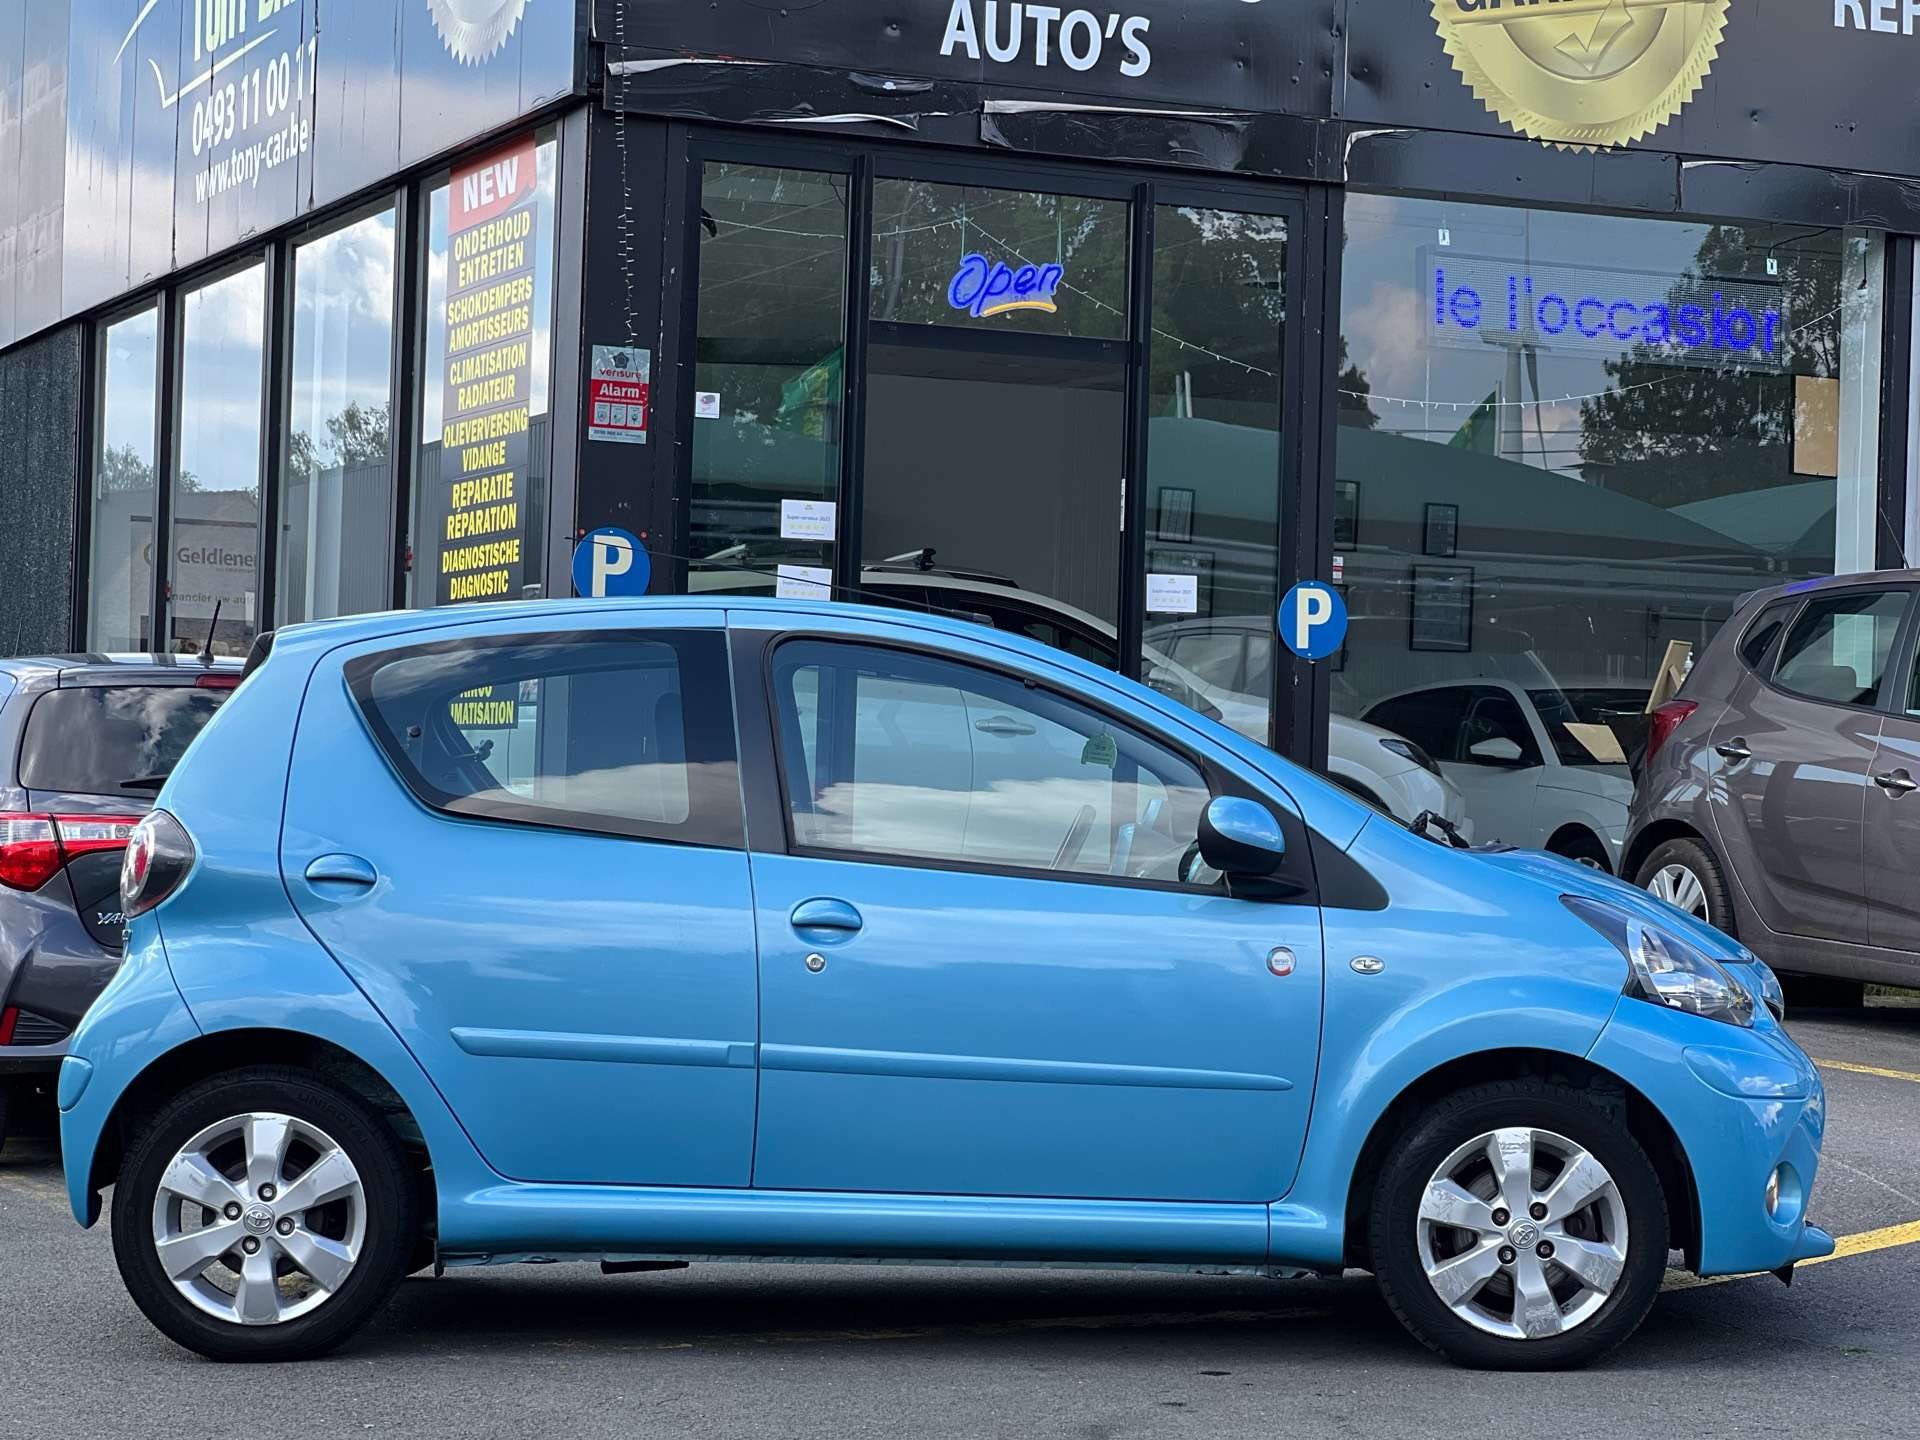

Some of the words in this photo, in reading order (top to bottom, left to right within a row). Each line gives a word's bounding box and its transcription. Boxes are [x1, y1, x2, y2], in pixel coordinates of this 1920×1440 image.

[940, 0, 1151, 77] AUTO'S
[192, 83, 235, 156] 0493
[241, 68, 260, 130] 11
[266, 52, 290, 117] 00
[295, 36, 317, 101] 11
[195, 112, 309, 203] www.tony-car.be
[463, 156, 518, 213] NEW
[454, 211, 530, 261] ONDERHOUD
[459, 241, 524, 287] ENTRETIEN
[950, 254, 1064, 317] Open
[447, 275, 533, 325] SCHOKDEMPERS
[1435, 268, 1482, 328] le
[449, 306, 529, 352] AMORTISSEURS
[450, 342, 527, 385] CLIMATISATION
[600, 369, 642, 379] verisure
[458, 374, 515, 411] RADIATEUR
[600, 383, 640, 398] Alarm
[443, 407, 529, 448] OLIEVERVERSING
[462, 441, 507, 472] VIDANGE
[452, 472, 514, 509] REPARATIE
[447, 503, 517, 540] RÉPARATION
[442, 539, 520, 574] DIAGNOSTISCHE
[592, 535, 633, 597] P
[451, 570, 509, 600] DIAGNOSTIC
[1296, 588, 1332, 648] P
